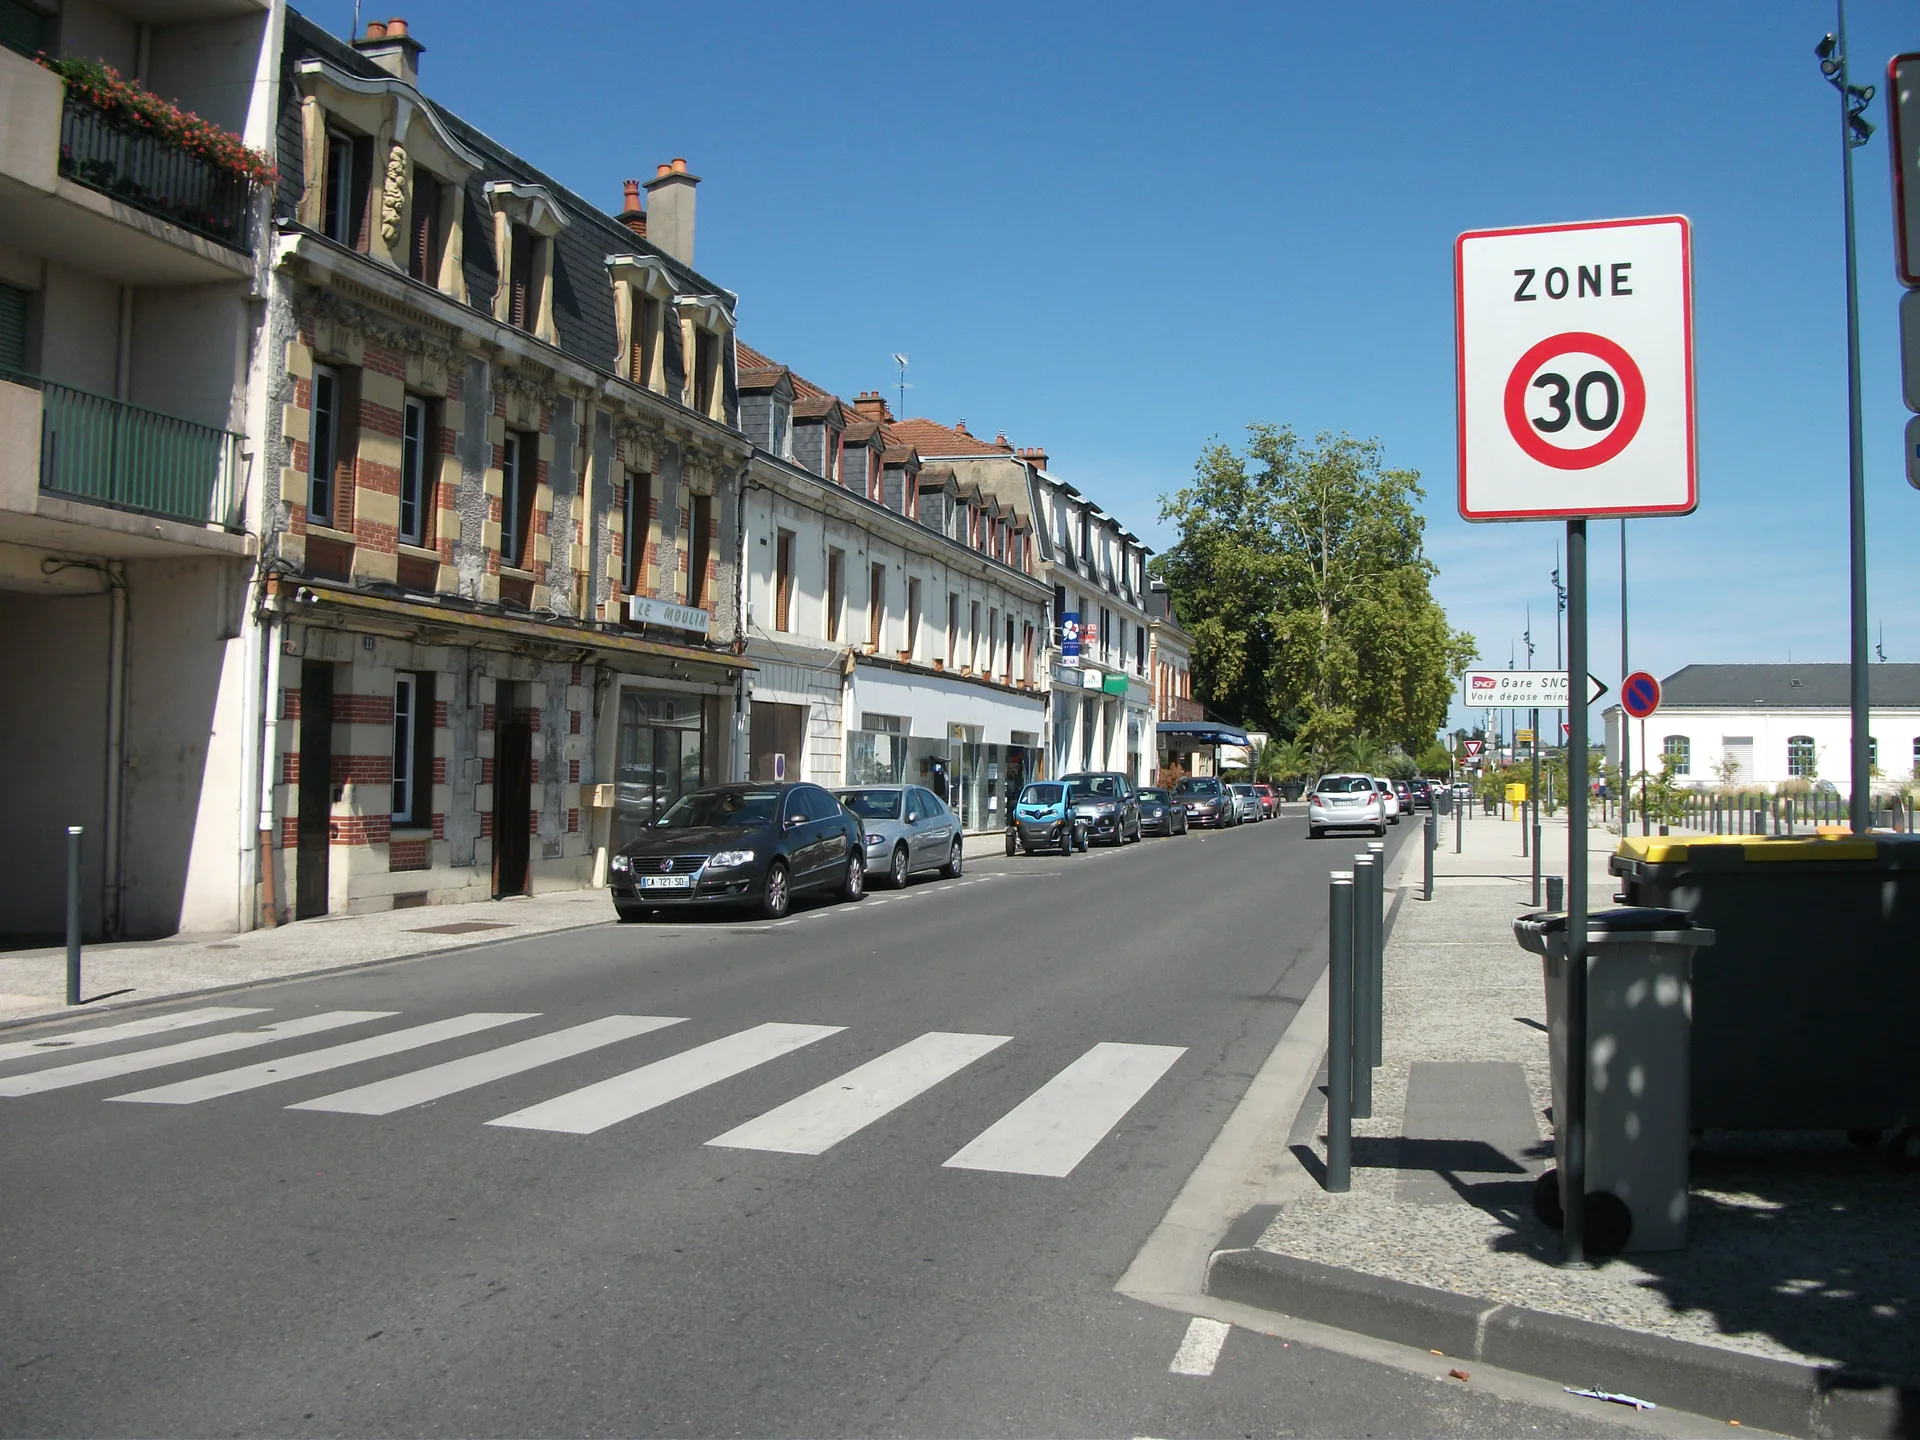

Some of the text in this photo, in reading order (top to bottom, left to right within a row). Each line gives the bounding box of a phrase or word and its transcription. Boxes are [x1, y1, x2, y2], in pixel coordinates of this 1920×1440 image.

[1514, 262, 1633, 302] ZONE
[1532, 370, 1620, 433] 30
[637, 602, 707, 628] LE MOULIN
[1473, 680, 1496, 689] SNCF
[1501, 677, 1568, 688] Gare SNC
[1471, 692, 1569, 702] Voie dépose minu
